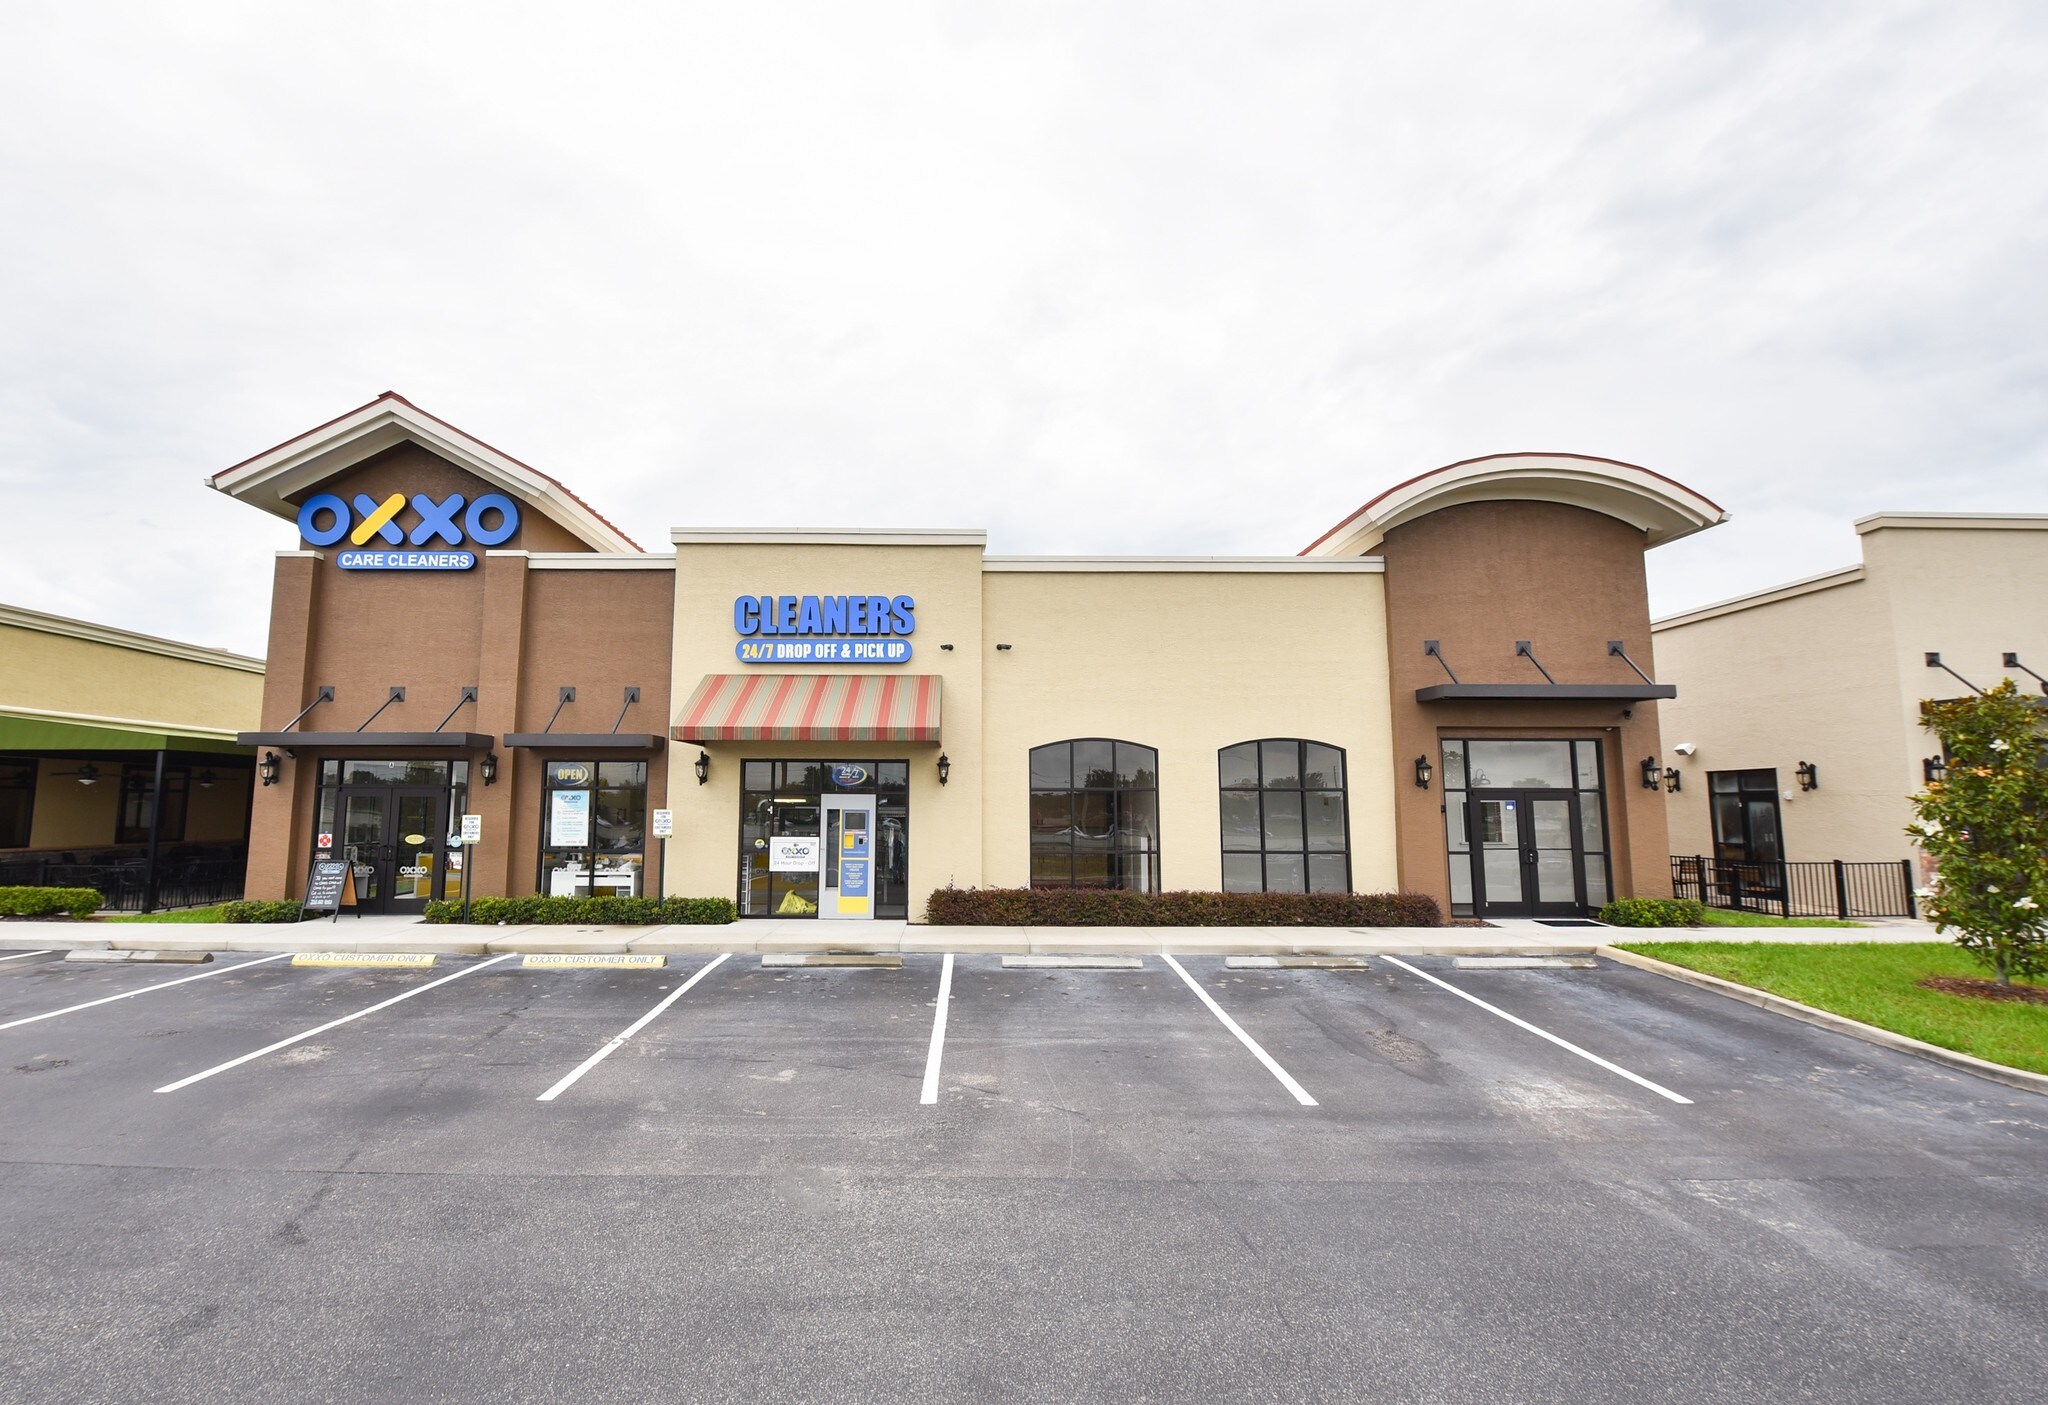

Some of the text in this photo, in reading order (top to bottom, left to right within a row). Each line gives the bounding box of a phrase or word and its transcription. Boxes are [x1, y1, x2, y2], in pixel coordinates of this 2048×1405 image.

[297, 493, 520, 547] OXXO
[342, 553, 469, 567] CARE CLEANERS
[734, 595, 915, 635] CLEANERS
[742, 643, 905, 659] 24/7 DROP OFF & PICK UP
[557, 768, 583, 780] OPEN
[399, 866, 428, 874] OXXO
[333, 954, 394, 962] CUSTOMER
[529, 955, 562, 963] OXXO
[565, 955, 625, 963] CUSTOMER
